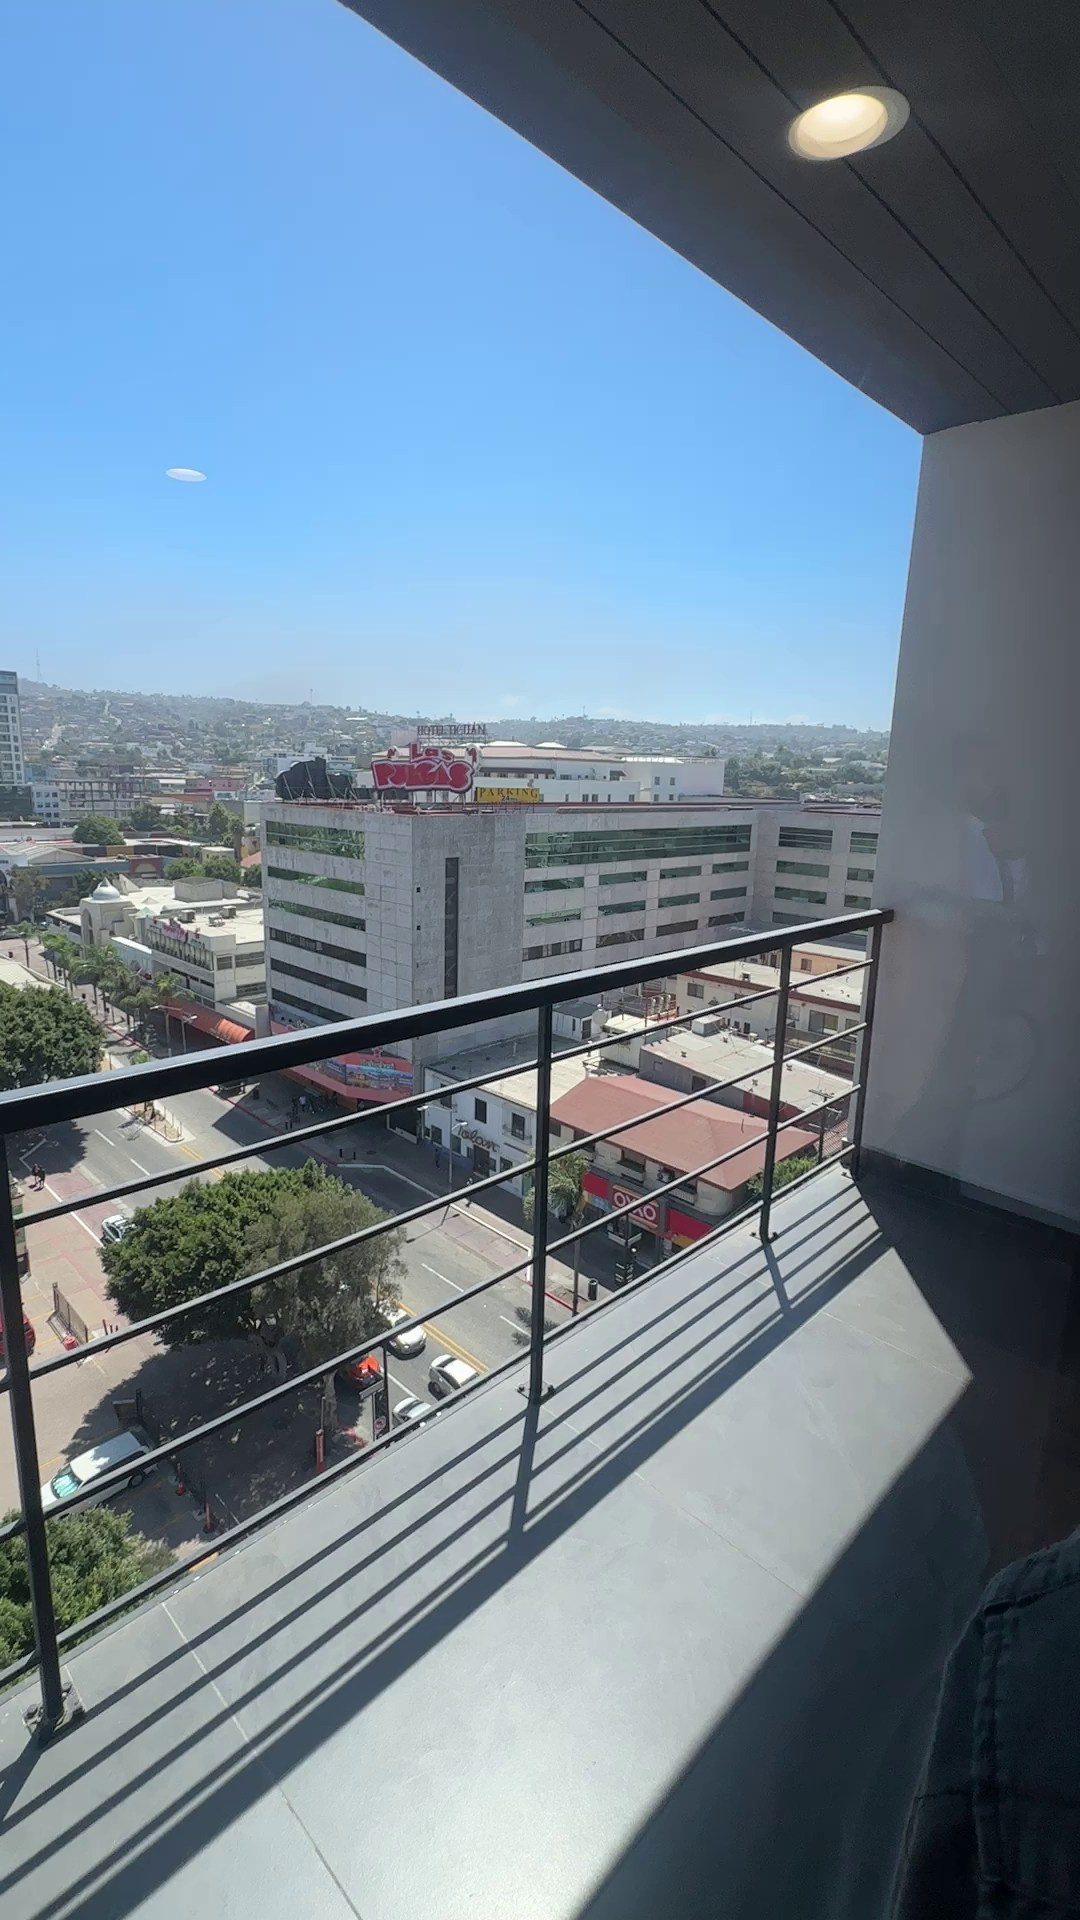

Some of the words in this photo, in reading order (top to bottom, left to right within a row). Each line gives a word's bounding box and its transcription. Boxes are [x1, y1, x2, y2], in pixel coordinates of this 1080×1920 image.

[417, 725, 444, 736] HOTEL
[371, 759, 474, 794] PULGAS
[479, 788, 538, 799] PARKING
